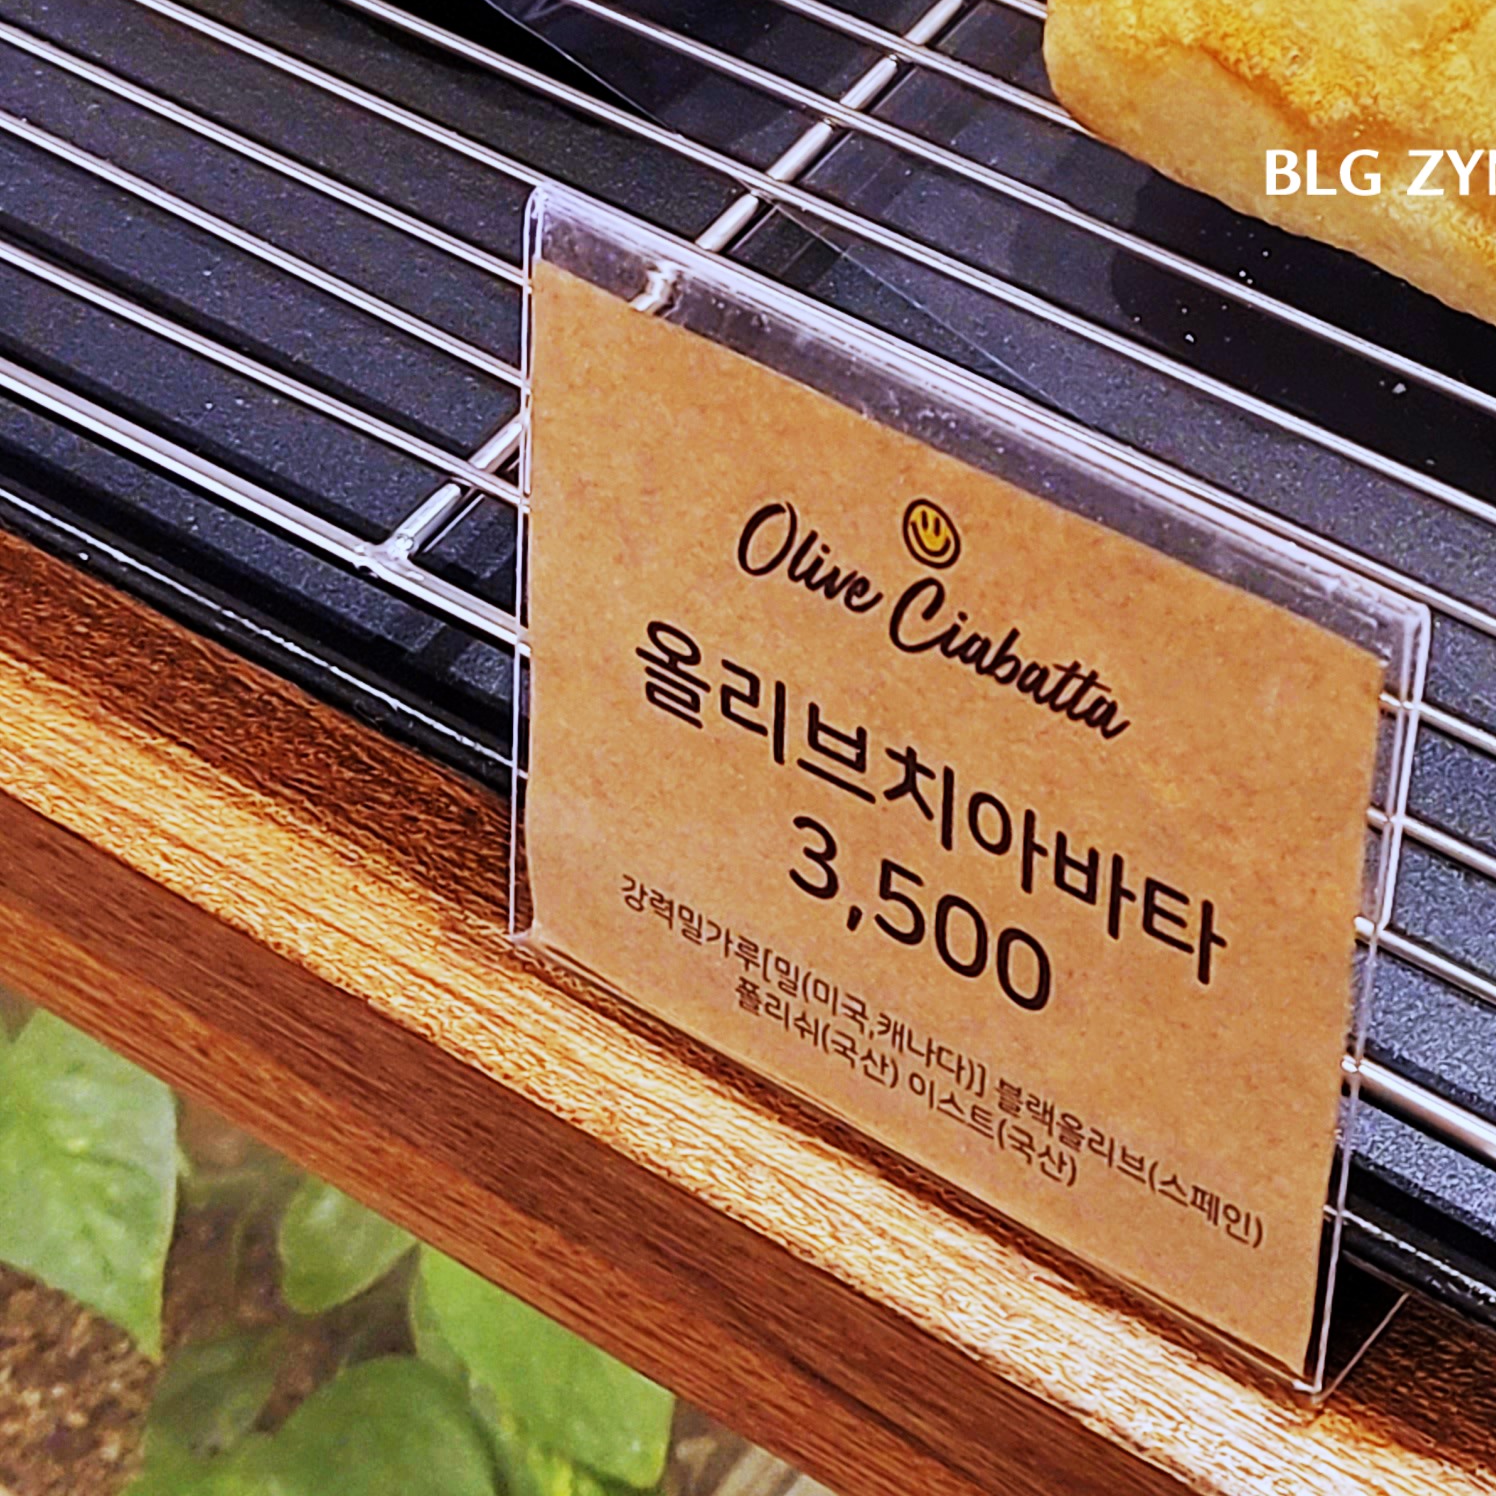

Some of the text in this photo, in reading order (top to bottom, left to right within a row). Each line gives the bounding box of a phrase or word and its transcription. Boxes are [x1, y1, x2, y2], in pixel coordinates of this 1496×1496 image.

[737, 501, 1131, 740] Olive Ciabatta
[635, 619, 1228, 985] 올리브치아바타
[788, 815, 1053, 1012] 3,500
[908, 1072, 1077, 1187] 이스트(국산)
[995, 1077, 1264, 1249] 블랙올리브(스페인)
